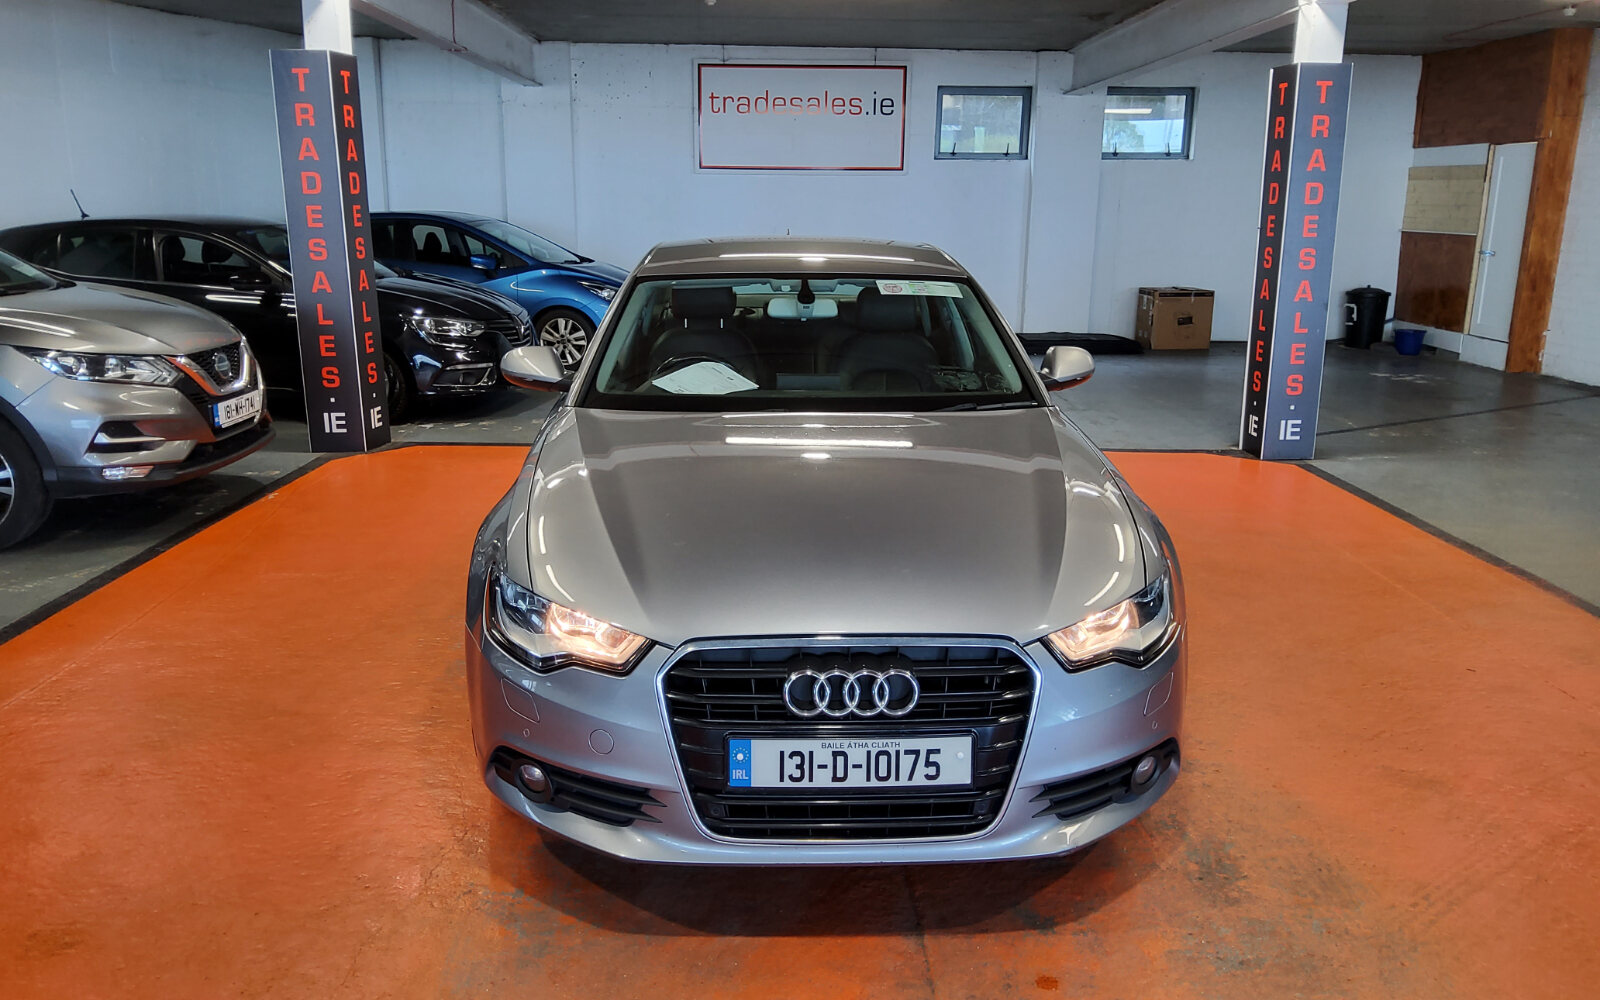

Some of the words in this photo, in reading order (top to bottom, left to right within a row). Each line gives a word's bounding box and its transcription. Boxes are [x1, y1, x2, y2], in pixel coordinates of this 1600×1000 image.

[709, 90, 895, 116] tradesales.ie
[847, 740, 869, 749] ÁTHA
[871, 741, 900, 749] CLIATH
[732, 769, 748, 780] IRL
[779, 748, 941, 783] 131-D-10175
